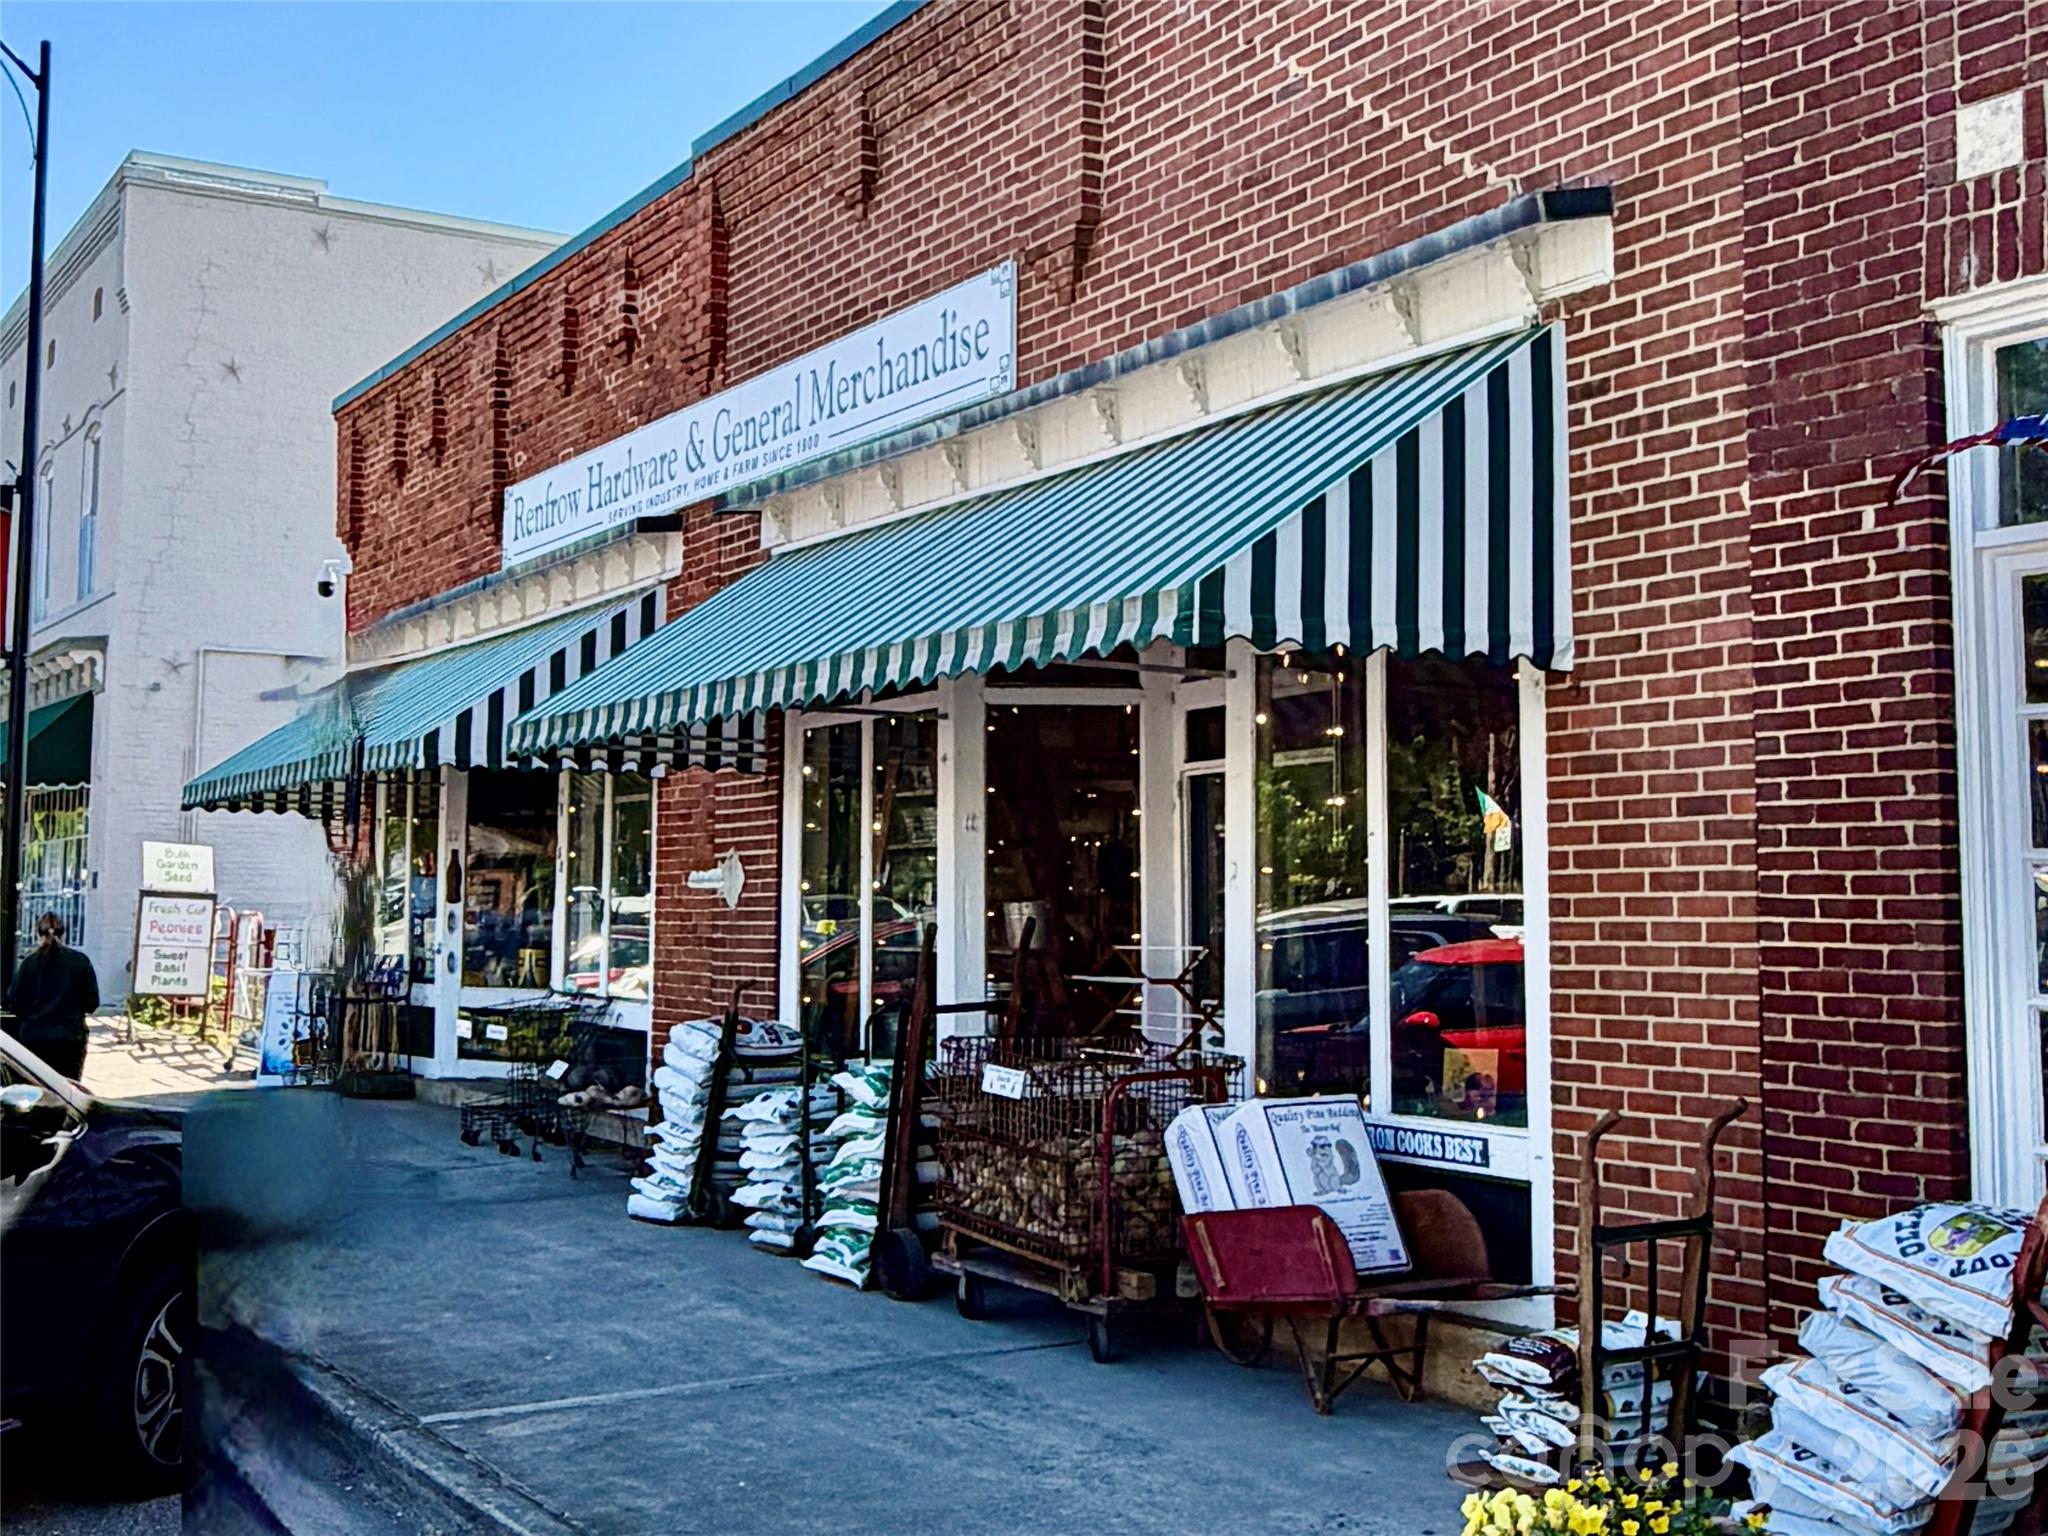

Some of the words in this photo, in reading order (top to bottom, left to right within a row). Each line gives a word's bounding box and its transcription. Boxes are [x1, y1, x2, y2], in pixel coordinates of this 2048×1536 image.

[513, 481, 582, 541] Renfrow
[586, 446, 678, 513] Hardware
[685, 421, 706, 473] &
[713, 374, 801, 463] General
[808, 308, 990, 426] Merchandise
[694, 469, 720, 491] HOME
[733, 456, 759, 477] FARM
[763, 443, 793, 467] SINCE
[156, 859, 199, 871] Garden
[164, 871, 192, 883] Seed
[148, 902, 181, 914] Fresh
[187, 903, 206, 915] Cut
[150, 920, 203, 935] Peonies
[153, 948, 189, 961] Sweet
[154, 962, 186, 973] Basil
[151, 974, 189, 987] Plants
[1270, 1108, 1304, 1126] Quality
[1397, 1130, 1443, 1158] COOKS
